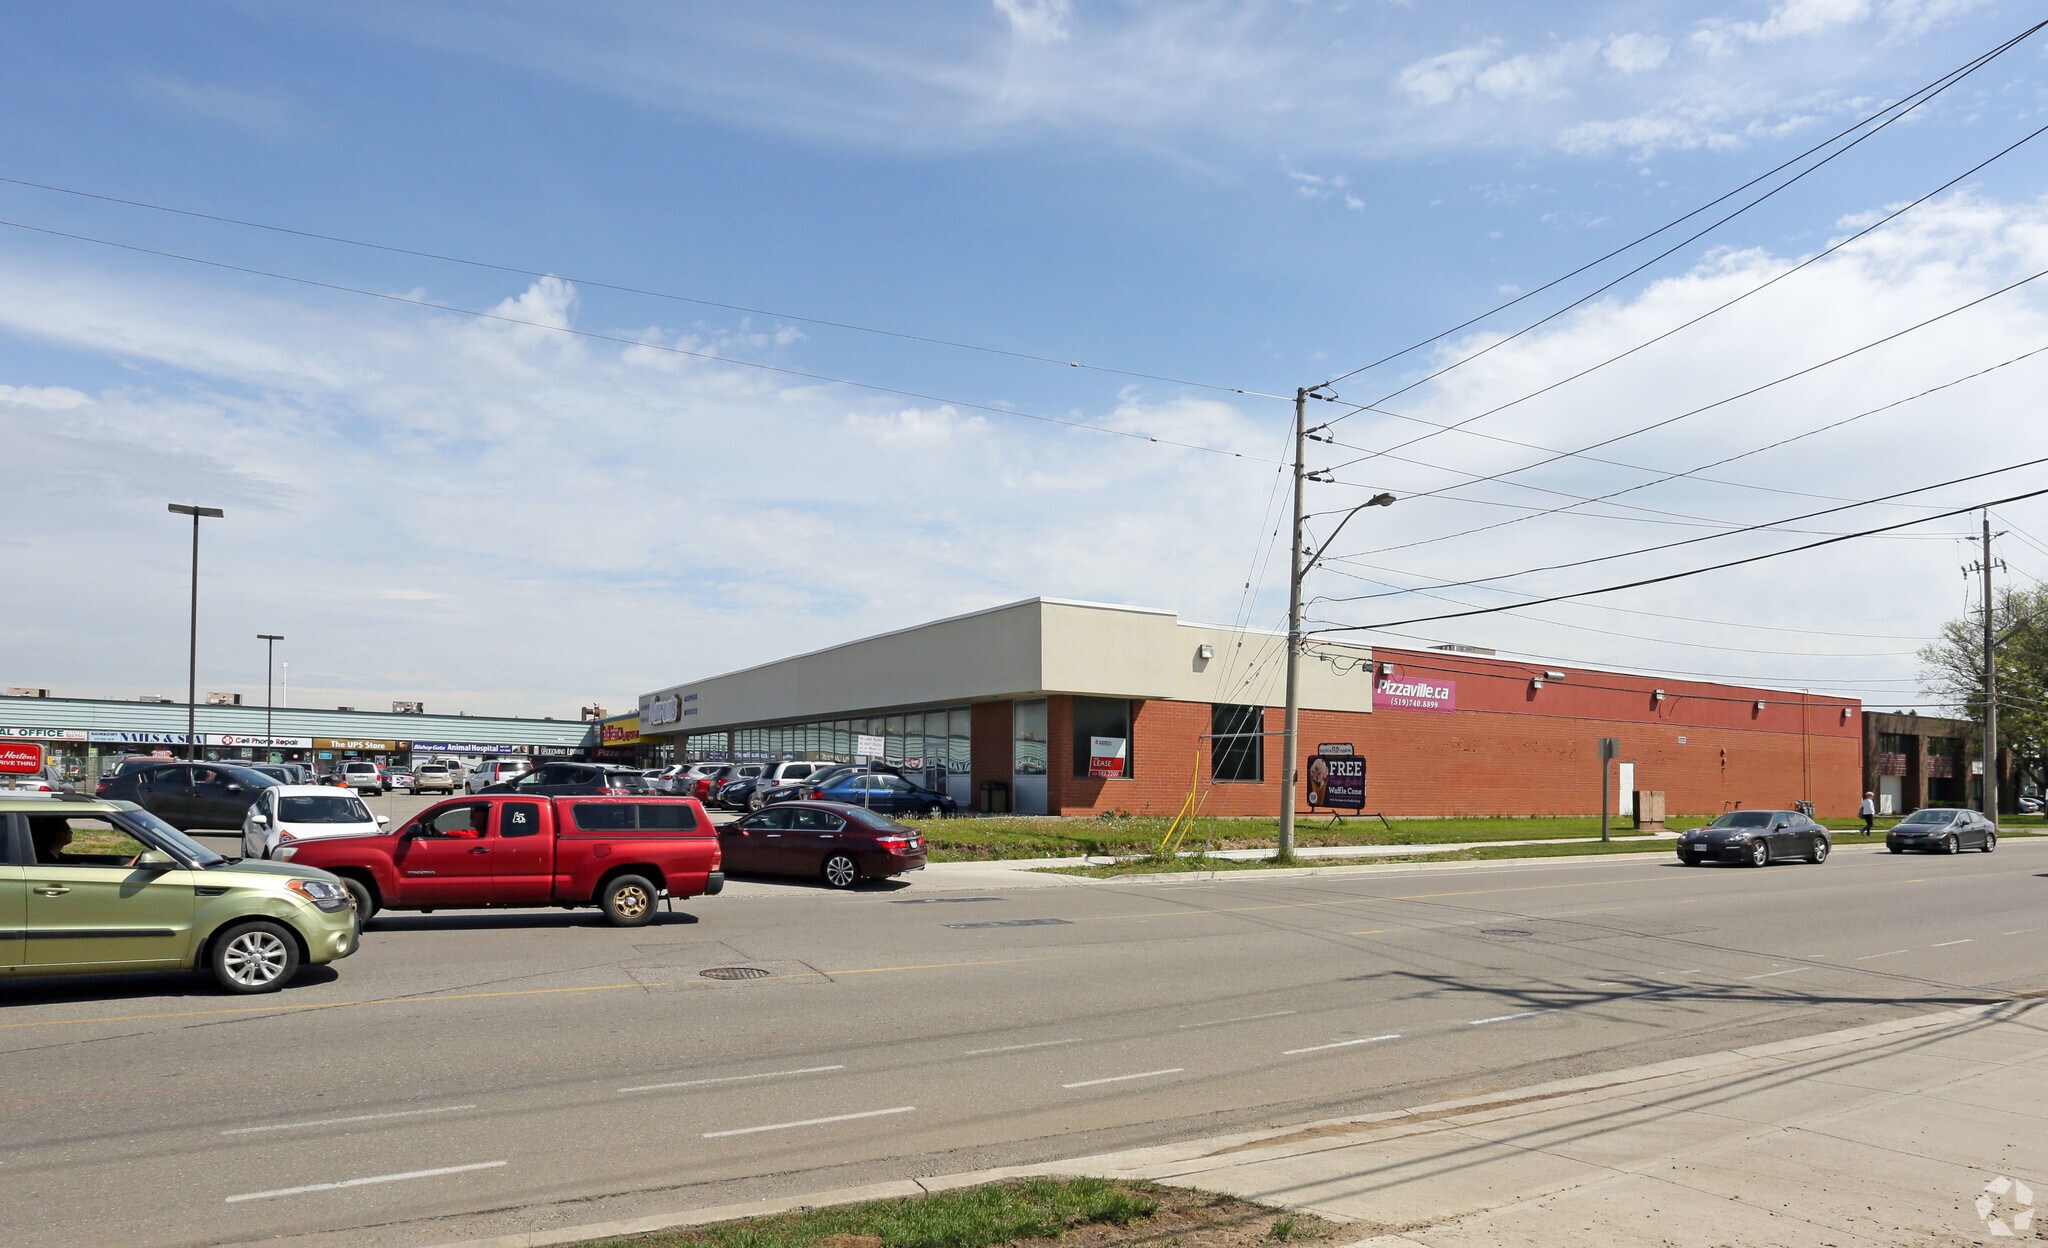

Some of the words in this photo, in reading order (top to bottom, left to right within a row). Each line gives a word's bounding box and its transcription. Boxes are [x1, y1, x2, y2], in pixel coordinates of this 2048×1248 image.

[1377, 679, 1449, 699] Pizzaville.ca
[1390, 697, 1439, 708] (519)740.8899
[19, 729, 64, 737] OFFICE
[121, 733, 160, 742] NAILS
[163, 734, 173, 743] &
[330, 740, 345, 748] The
[365, 741, 386, 749] Store
[447, 743, 471, 751] Animal
[472, 744, 498, 753] Hospital
[4, 751, 36, 759] Hortons
[1329, 761, 1362, 776] FREE
[1328, 787, 1347, 795] Waffle
[1347, 787, 1362, 795] Cone
